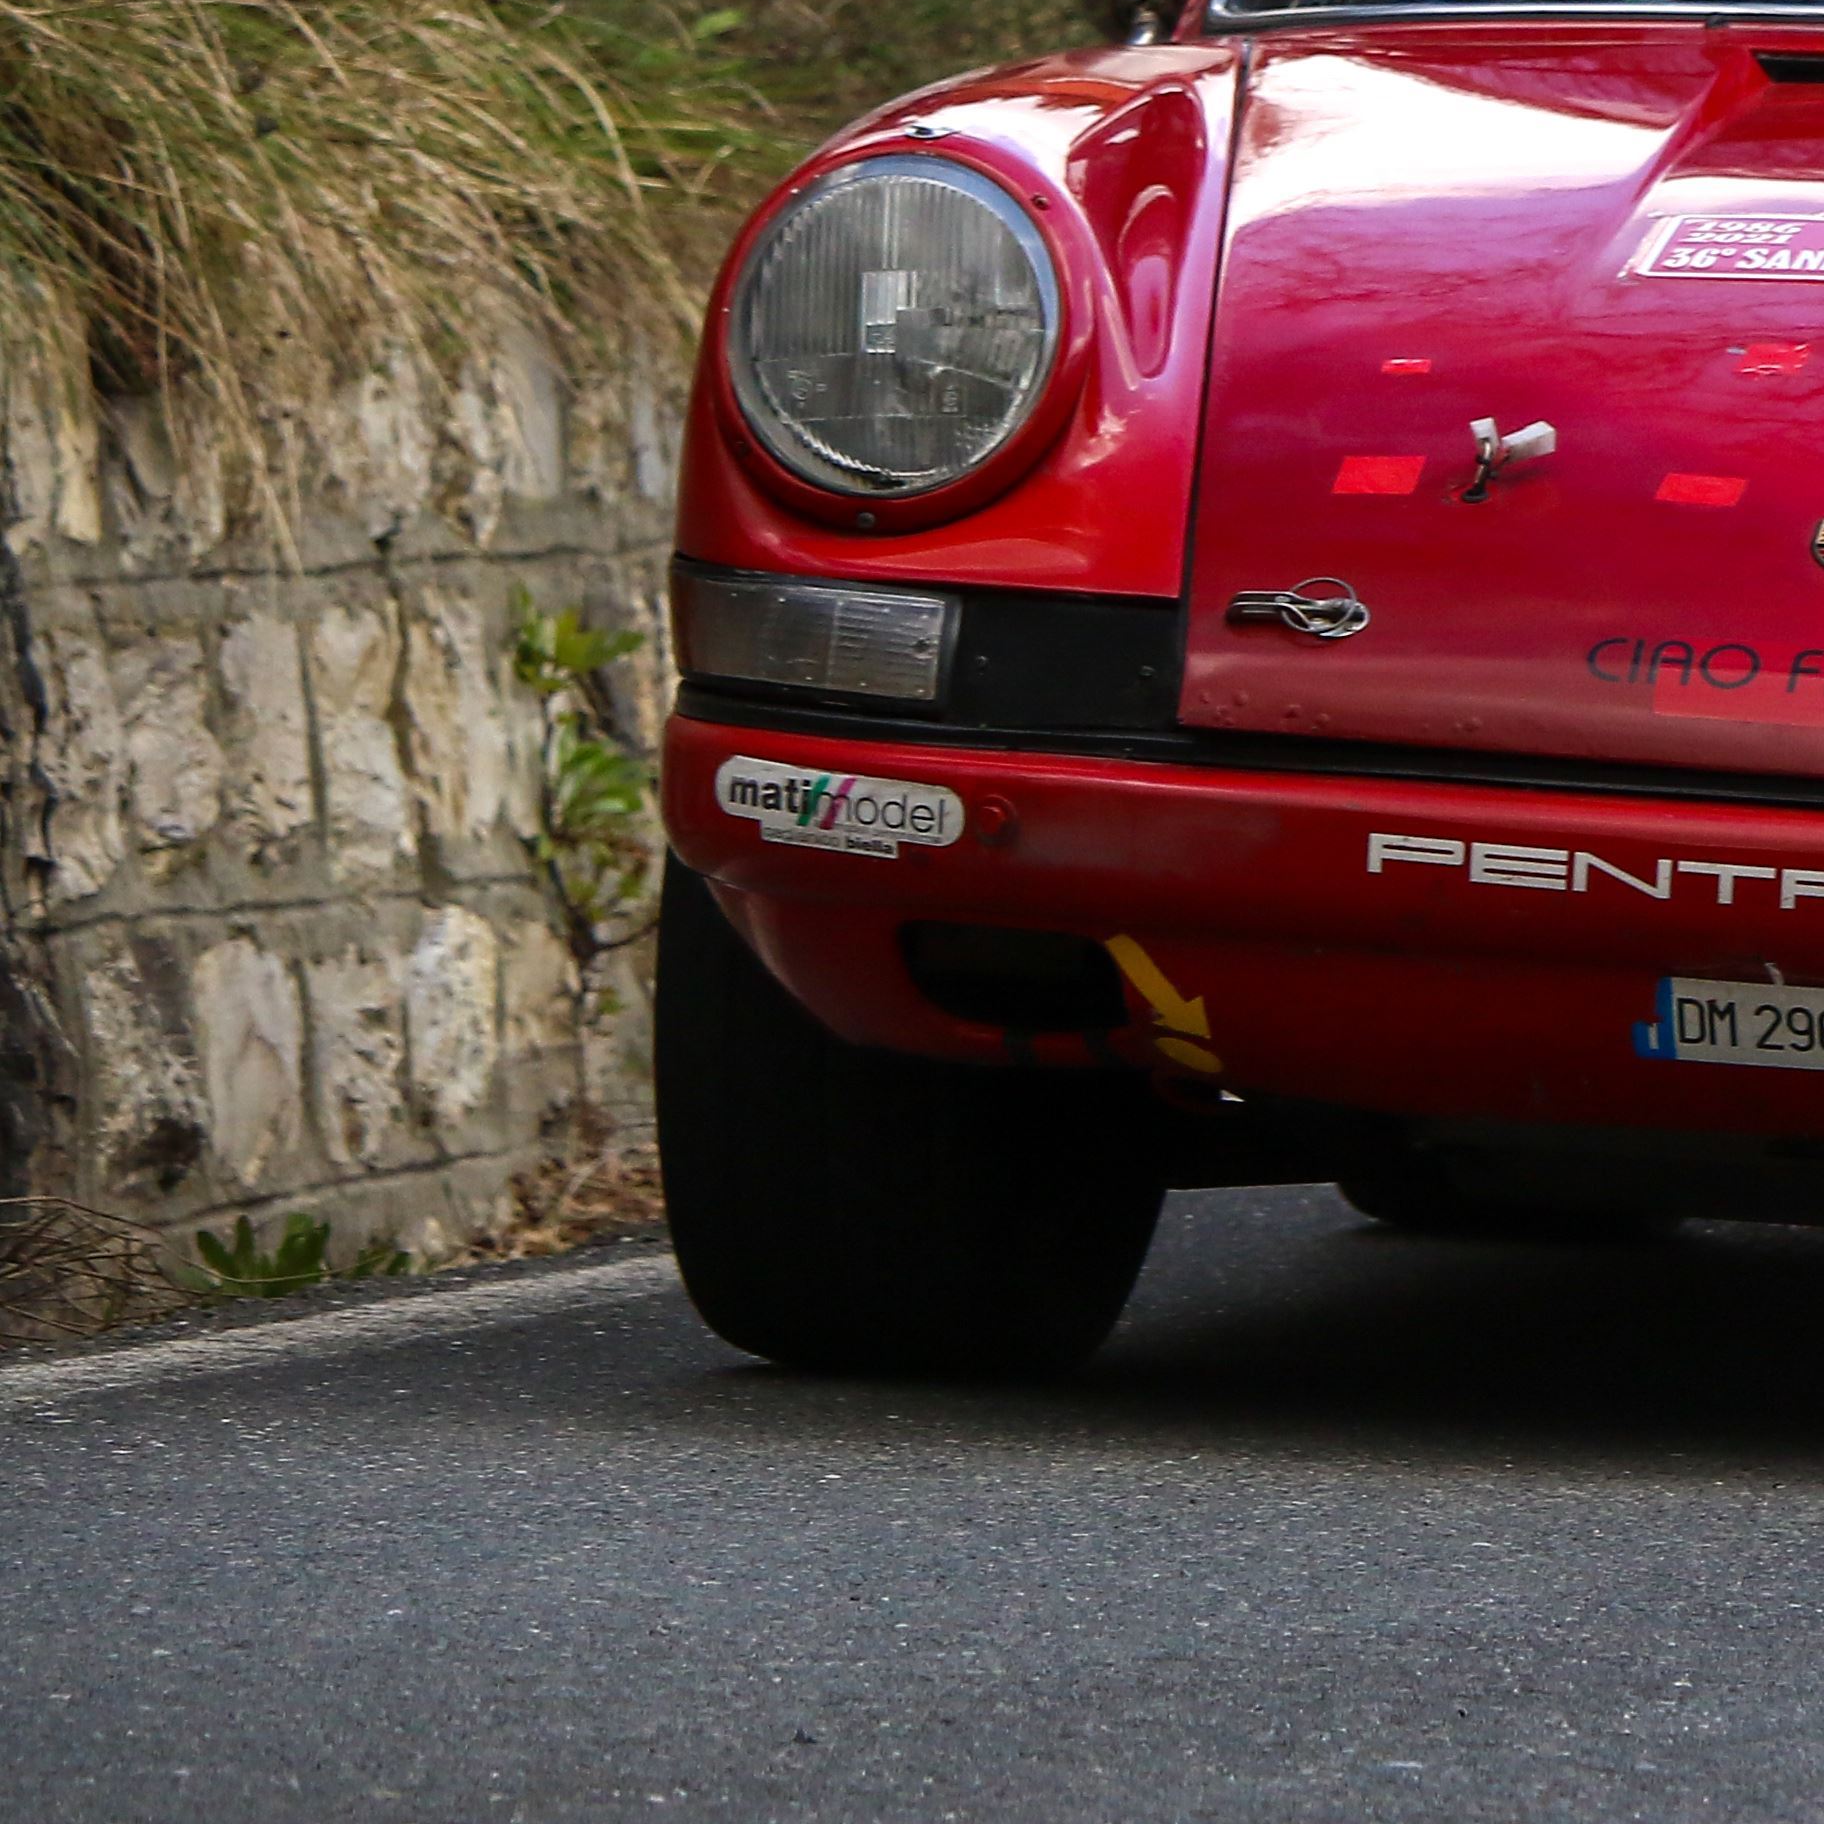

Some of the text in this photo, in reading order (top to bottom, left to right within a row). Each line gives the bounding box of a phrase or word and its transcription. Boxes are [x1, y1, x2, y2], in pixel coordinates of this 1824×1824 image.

[1679, 233, 1794, 245] 2021
[1688, 221, 1805, 234] 1986
[1587, 637, 1760, 690] CIAO
[1677, 997, 1738, 1047] DM
